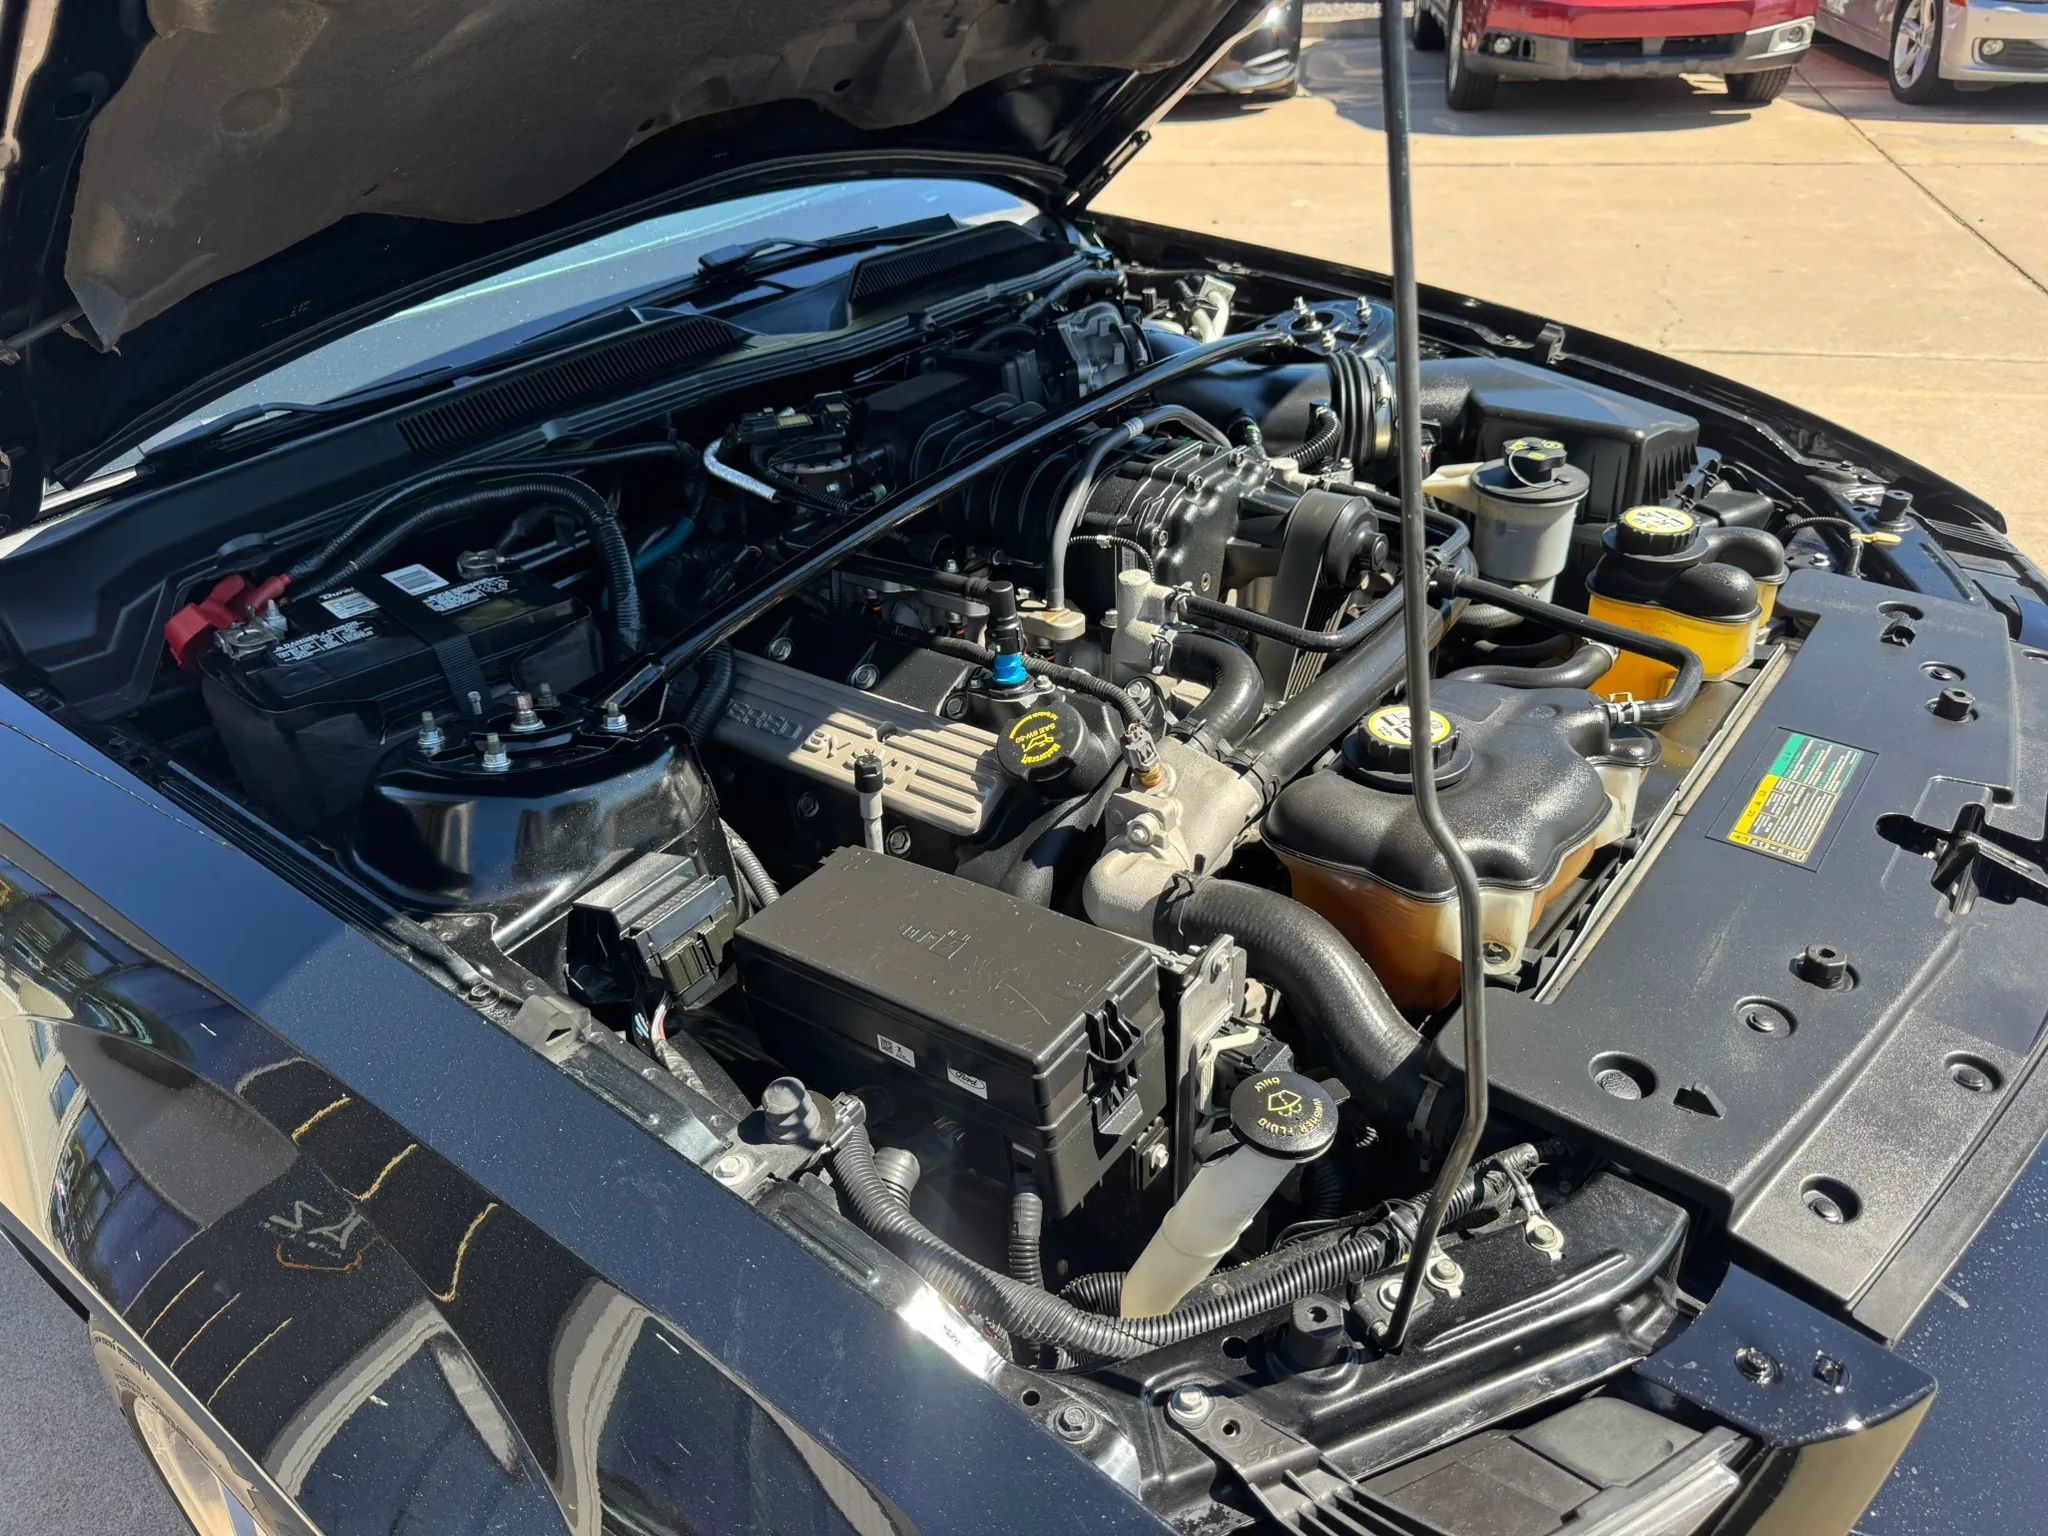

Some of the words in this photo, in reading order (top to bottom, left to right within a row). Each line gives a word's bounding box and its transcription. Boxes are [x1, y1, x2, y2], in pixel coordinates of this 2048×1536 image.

[1039, 722, 1056, 735] SAE
[800, 728, 853, 759] BY
[955, 1070, 978, 1087] Ford
[1253, 1076, 1281, 1093] ONLY
[1299, 1097, 1325, 1135] WASHER
[1257, 1117, 1295, 1137] FLUID
